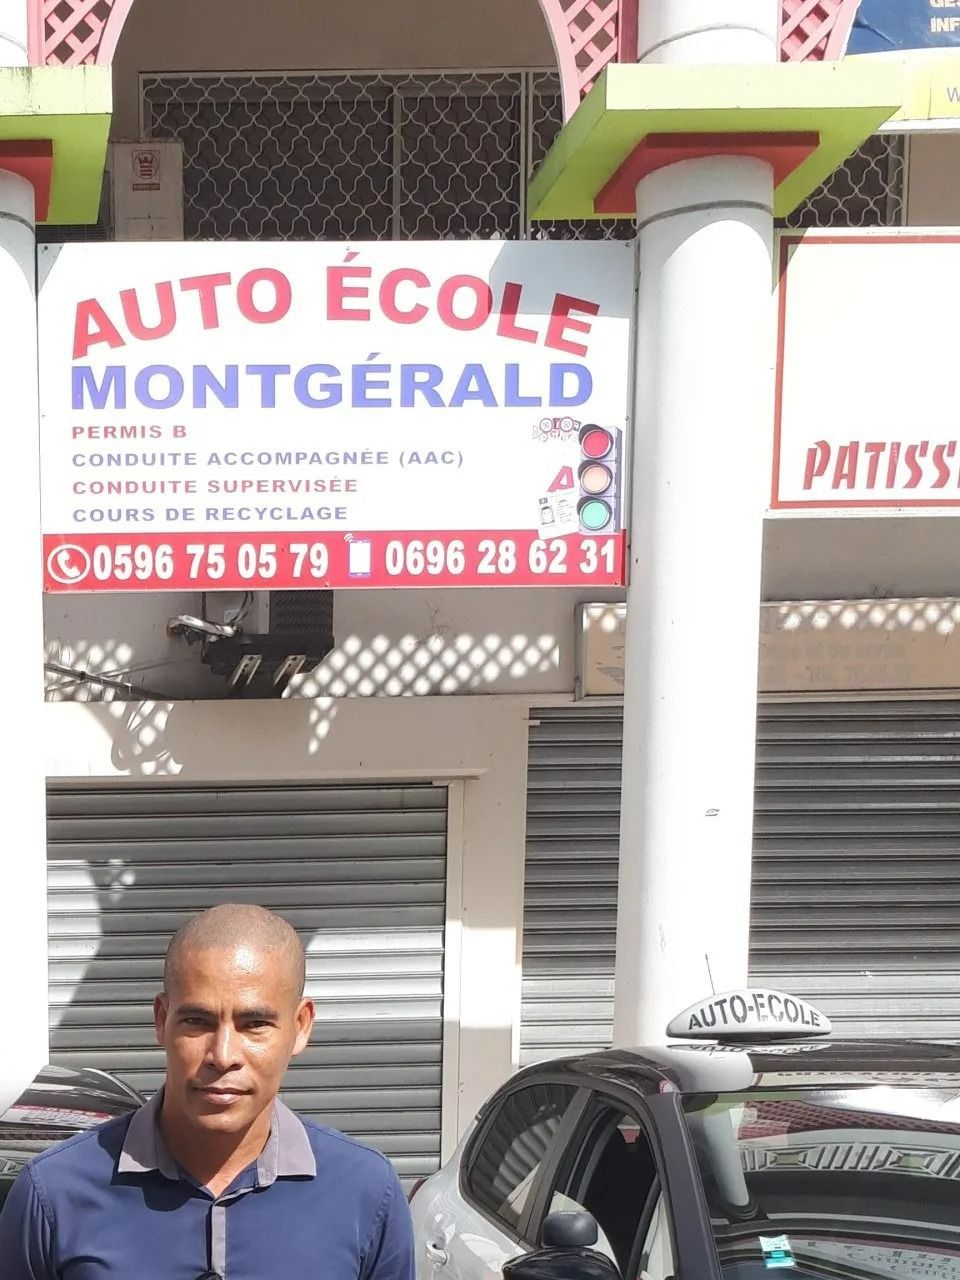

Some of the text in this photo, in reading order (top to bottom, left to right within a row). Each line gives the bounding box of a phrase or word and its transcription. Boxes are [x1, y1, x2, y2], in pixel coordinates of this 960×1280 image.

[72, 251, 600, 360] AUTO ÉCOLE
[71, 352, 593, 410] MONTGÉRALD
[72, 425, 187, 439] PERMIS B
[72, 449, 464, 468] CONDUITE ACCOMPAGNÉE (AAC)
[803, 440, 960, 490] PATISS
[73, 476, 358, 495] CONDUITE SUPERVISÉE
[73, 507, 348, 522] COURS DE RECYCLAGE
[93, 542, 329, 581] 0596 75 05 79
[385, 538, 616, 575] 0696 28 62 31
[688, 993, 821, 1031] AUTO-ECOLE
